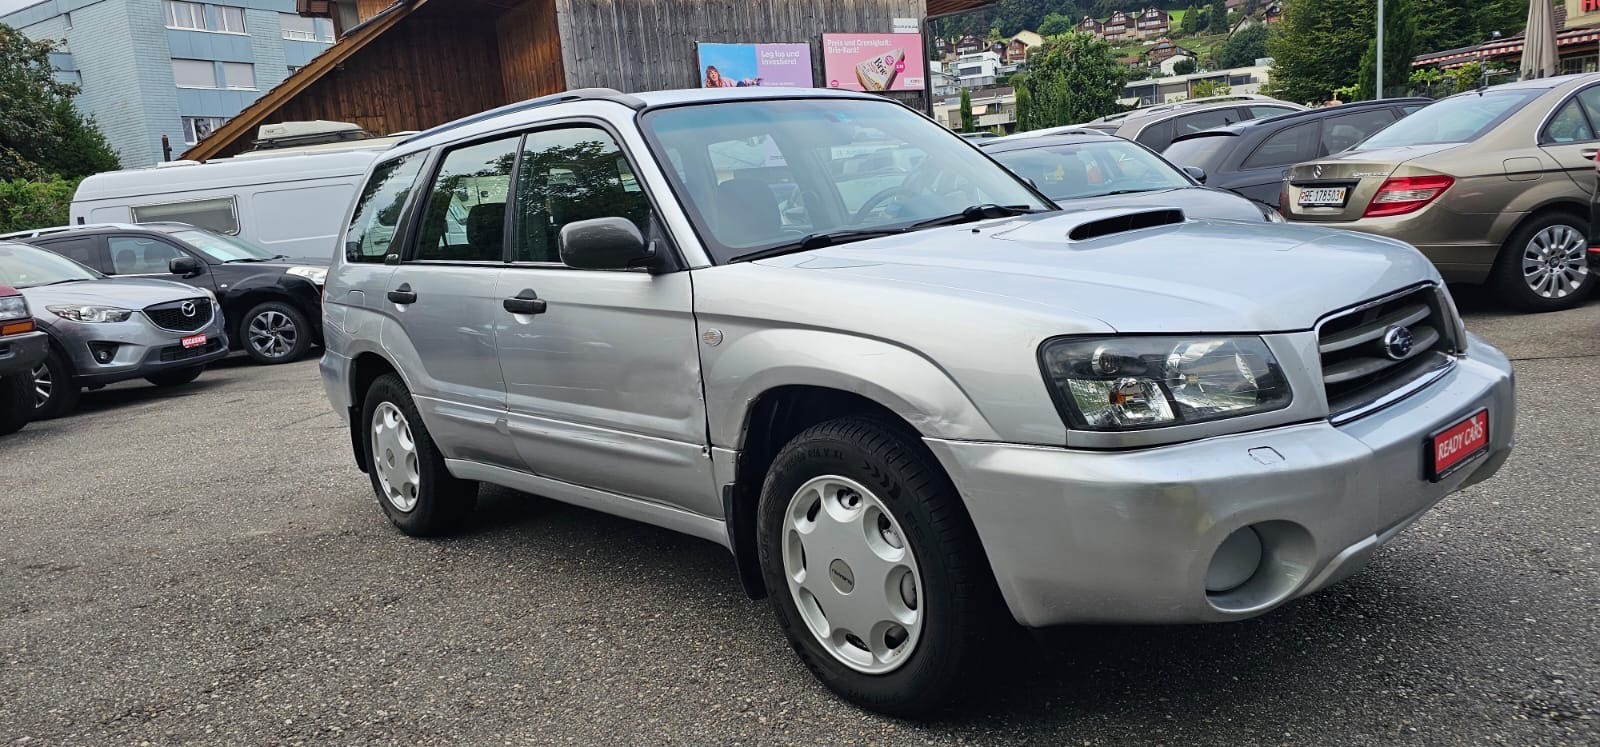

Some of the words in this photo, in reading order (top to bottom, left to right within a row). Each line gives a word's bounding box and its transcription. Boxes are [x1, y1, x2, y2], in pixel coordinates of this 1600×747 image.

[1581, 0, 1600, 12] H
[761, 50, 774, 59] Leg
[874, 58, 887, 76] Brie
[1438, 432, 1464, 461] READY
[1464, 422, 1483, 445] CARS
